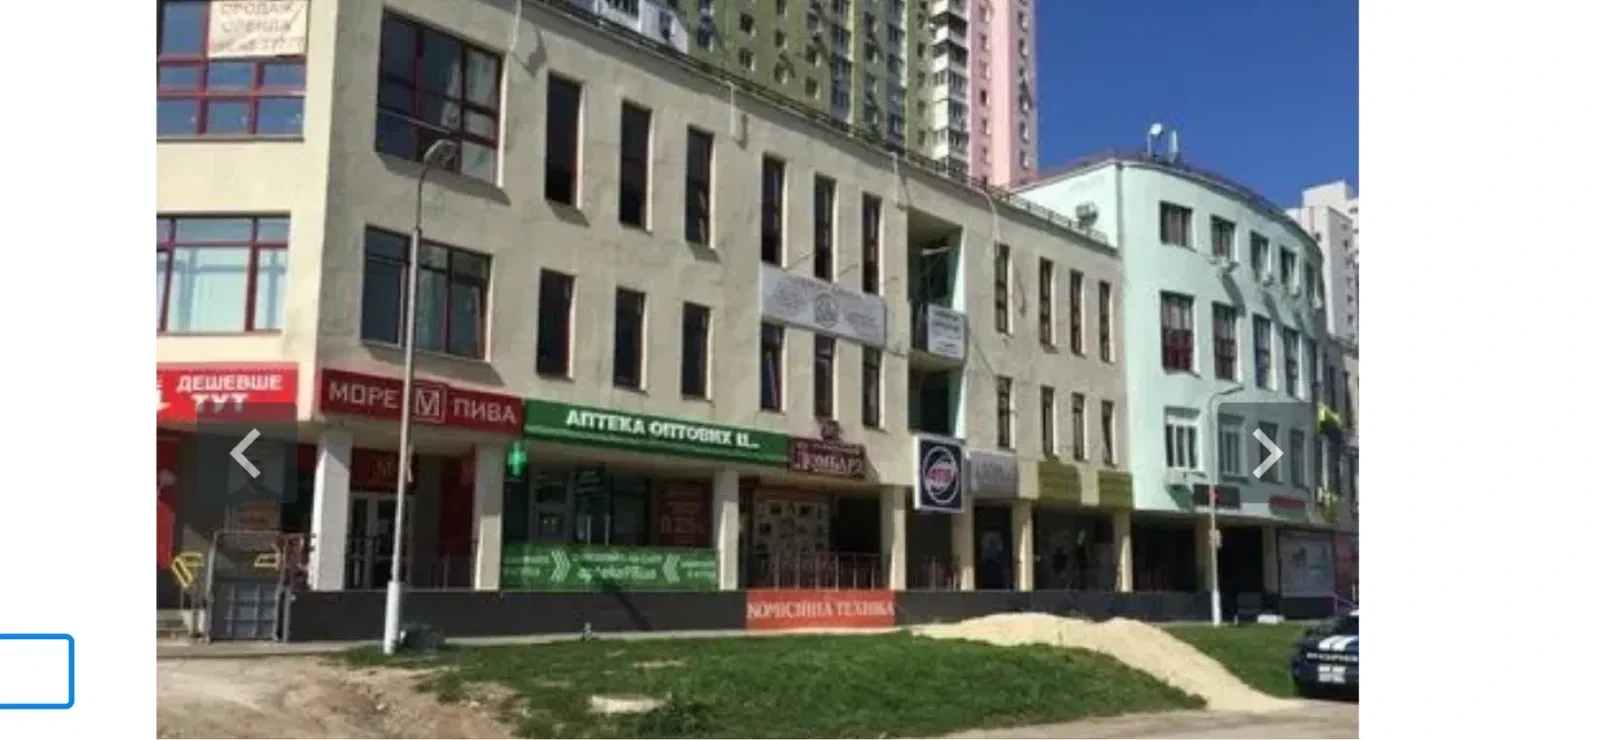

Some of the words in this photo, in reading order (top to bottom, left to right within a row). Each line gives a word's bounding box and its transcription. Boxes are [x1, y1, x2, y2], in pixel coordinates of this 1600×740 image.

[176, 374, 283, 393] ДЕШЕВШЕ
[190, 393, 248, 413] ТУТ
[328, 382, 399, 409] МОРЕ
[453, 398, 517, 424] ПИВА
[566, 408, 645, 434] АПТЕКА
[648, 421, 732, 446] ОПТОВИХ
